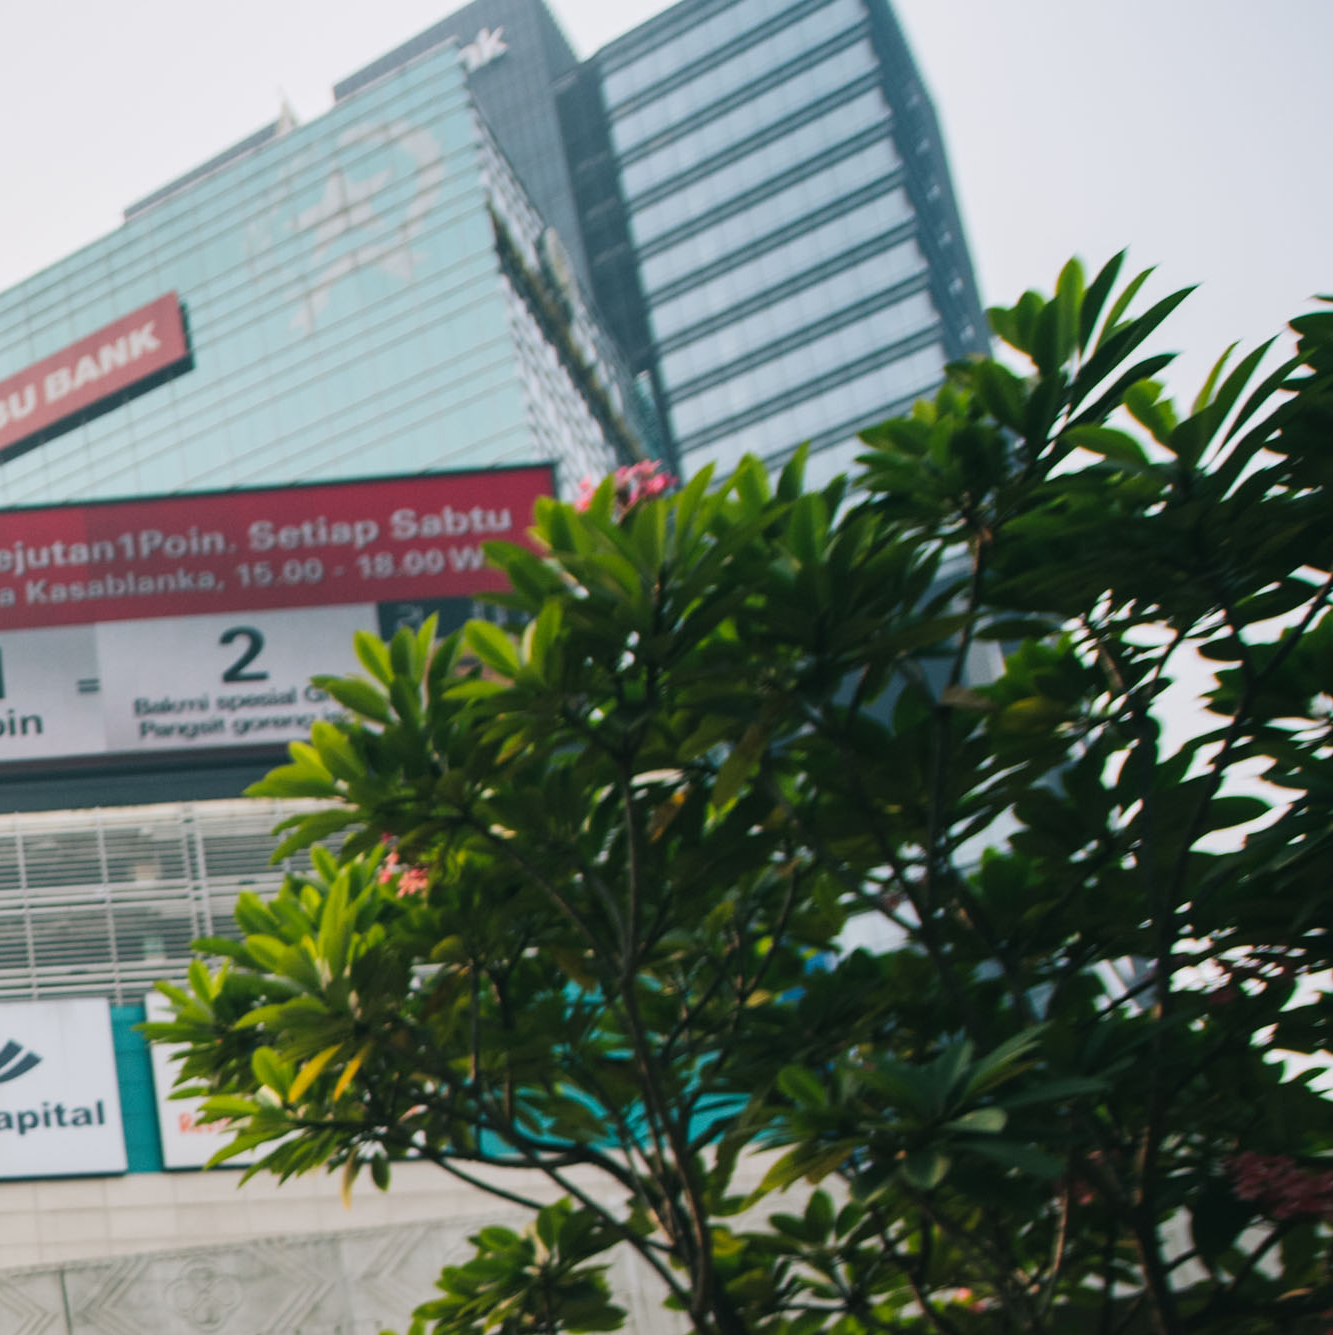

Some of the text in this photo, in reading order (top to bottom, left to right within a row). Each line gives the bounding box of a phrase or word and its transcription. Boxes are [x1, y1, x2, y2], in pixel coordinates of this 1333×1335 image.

[43, 320, 162, 404] BANK
[247, 516, 379, 550] Setiap
[389, 505, 512, 541] Sabtu
[25, 569, 225, 606] Kasablanka,
[357, 548, 445, 581] 18.00
[218, 625, 270, 684] 2
